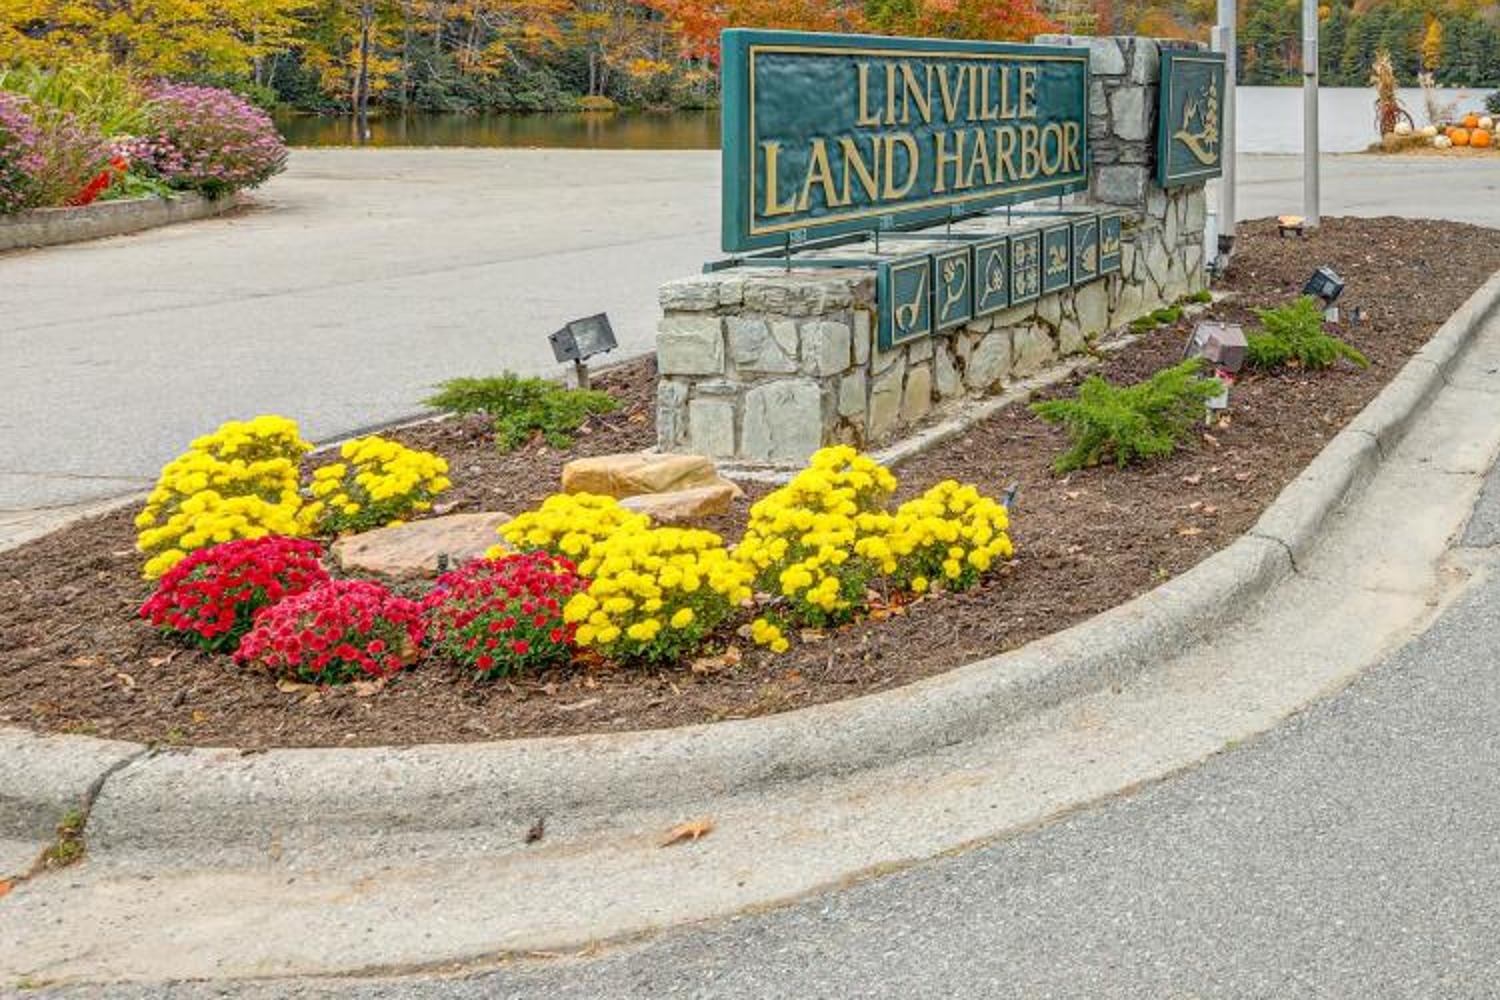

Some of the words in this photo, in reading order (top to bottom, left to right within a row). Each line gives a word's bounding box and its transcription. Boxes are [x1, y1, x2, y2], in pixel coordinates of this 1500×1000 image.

[857, 61, 1037, 127] LINVILLE
[761, 133, 919, 217] LAND
[933, 122, 1081, 192] HARBOR
